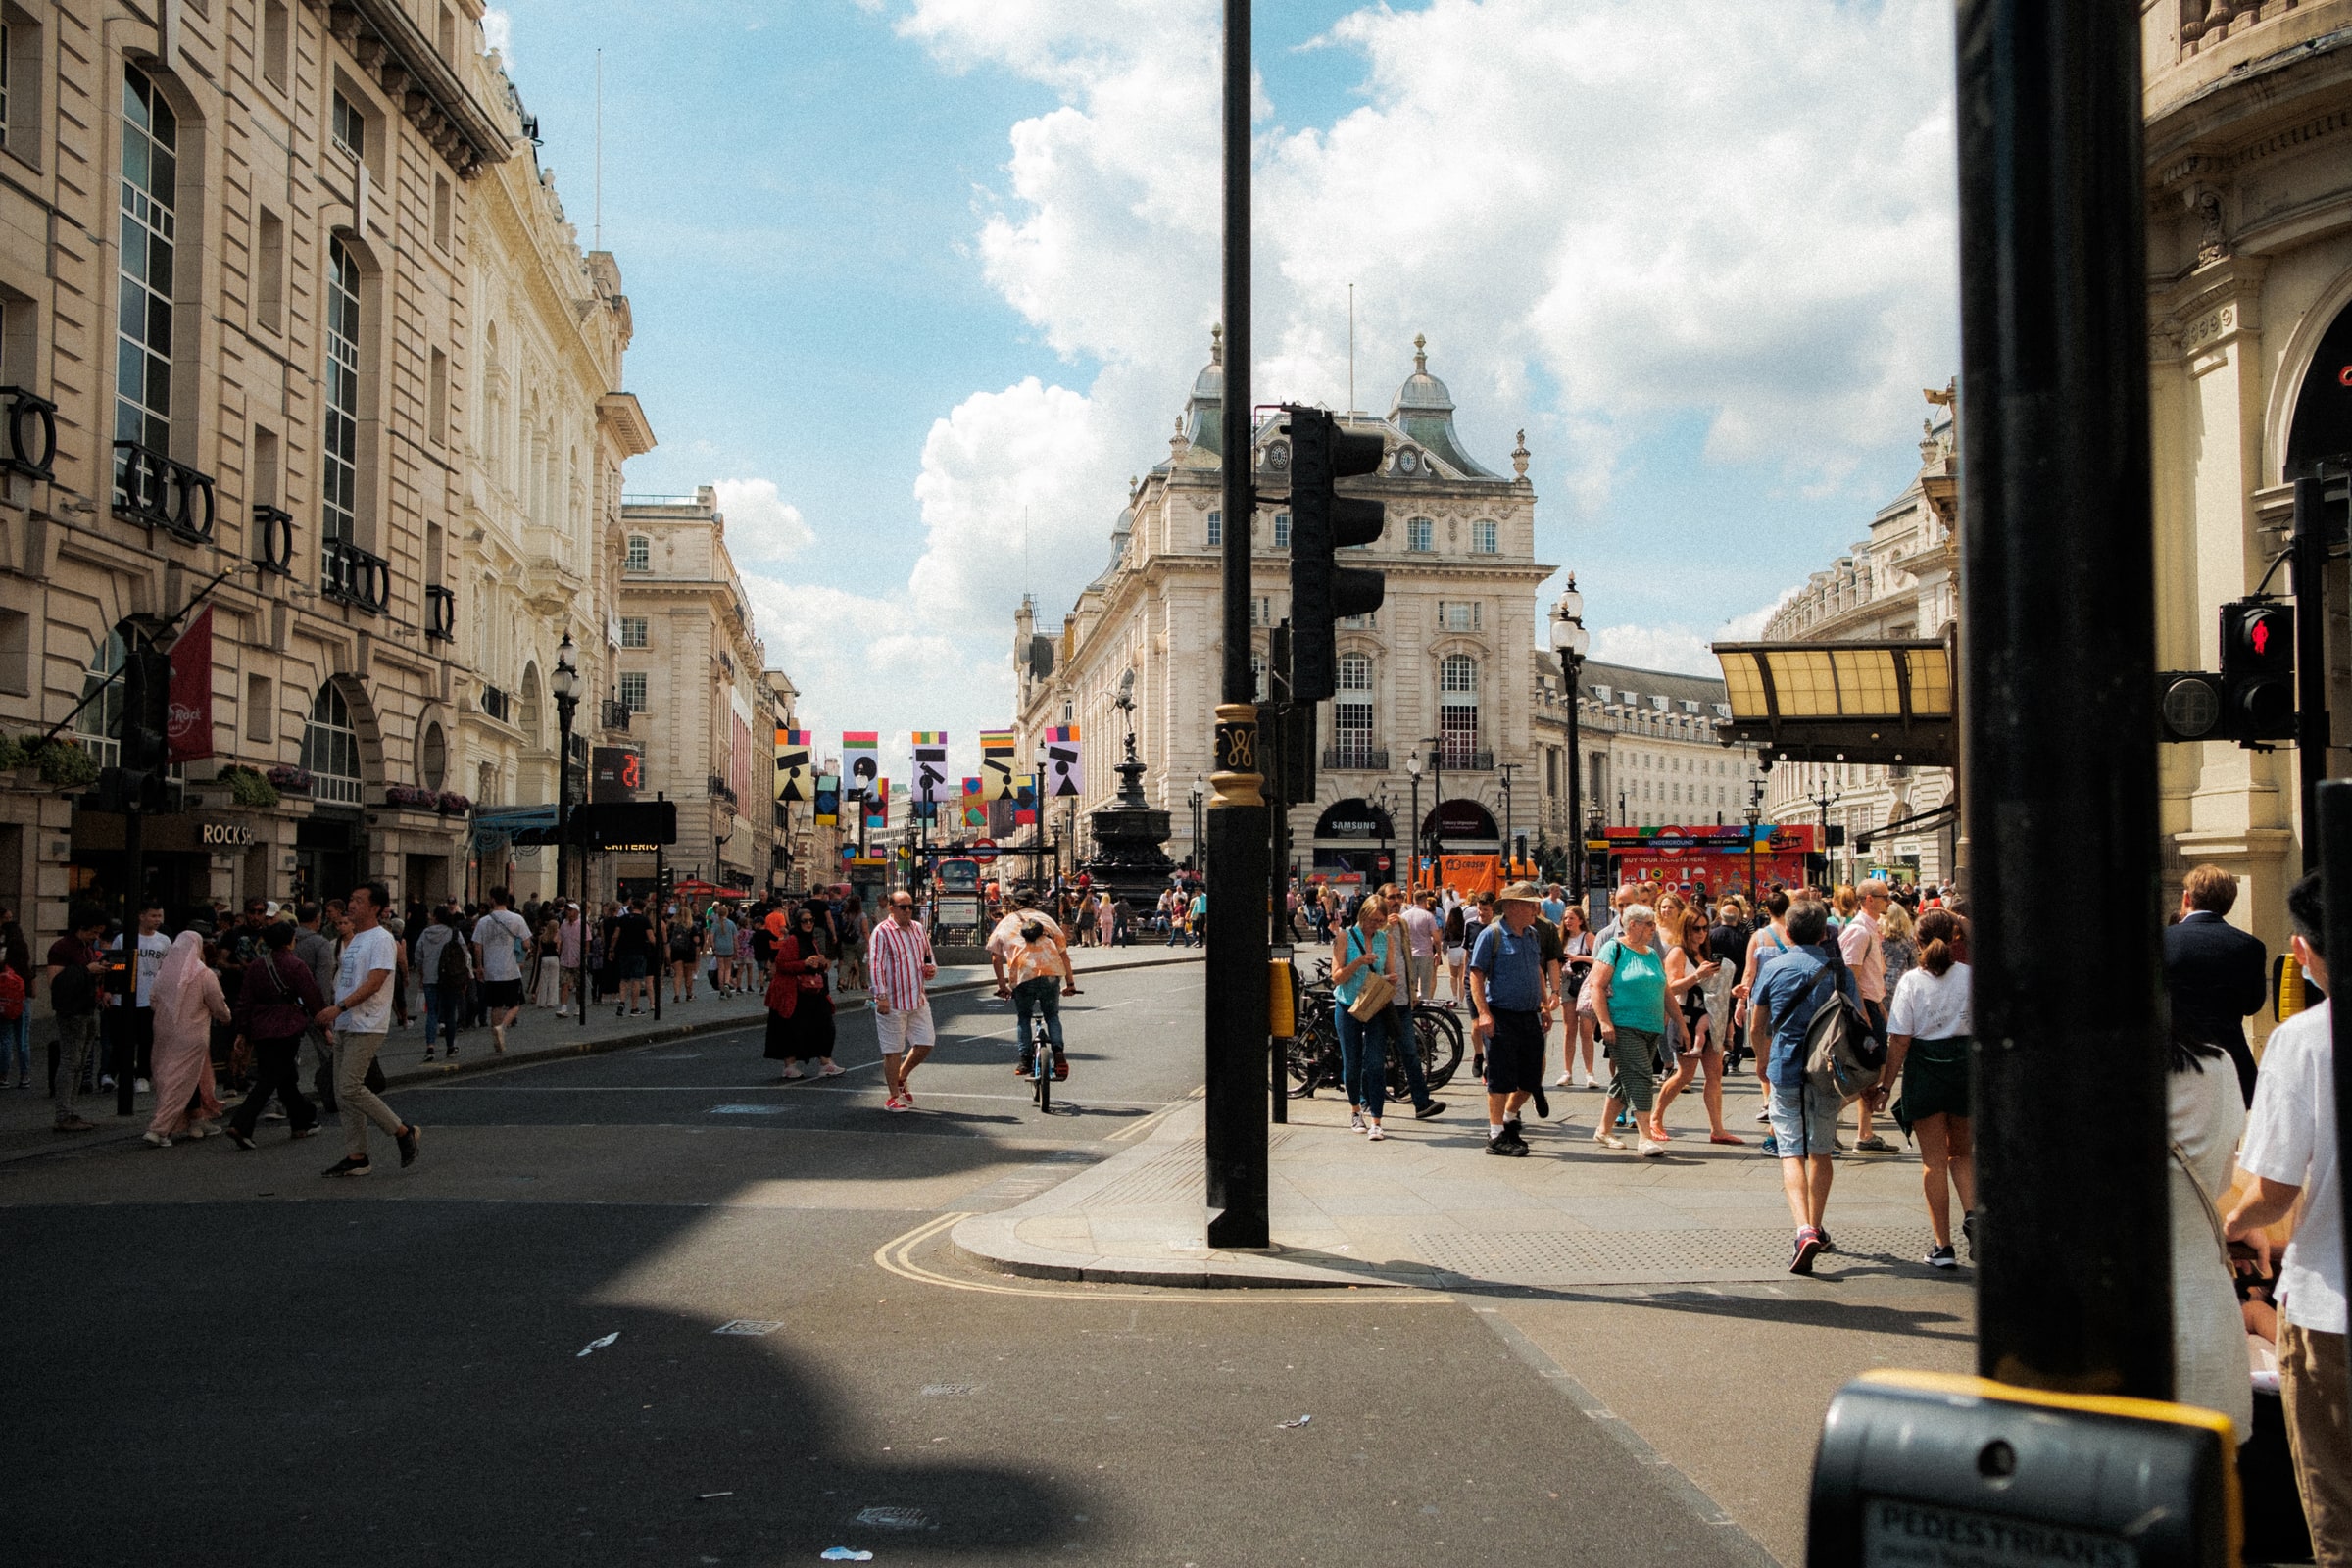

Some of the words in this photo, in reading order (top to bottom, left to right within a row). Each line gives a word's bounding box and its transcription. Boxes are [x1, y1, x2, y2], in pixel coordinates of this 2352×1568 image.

[203, 823, 240, 845] ROCK
[1332, 821, 1376, 830] SAMSUNG
[1882, 1505, 2129, 1568] PEDESTRIANS
